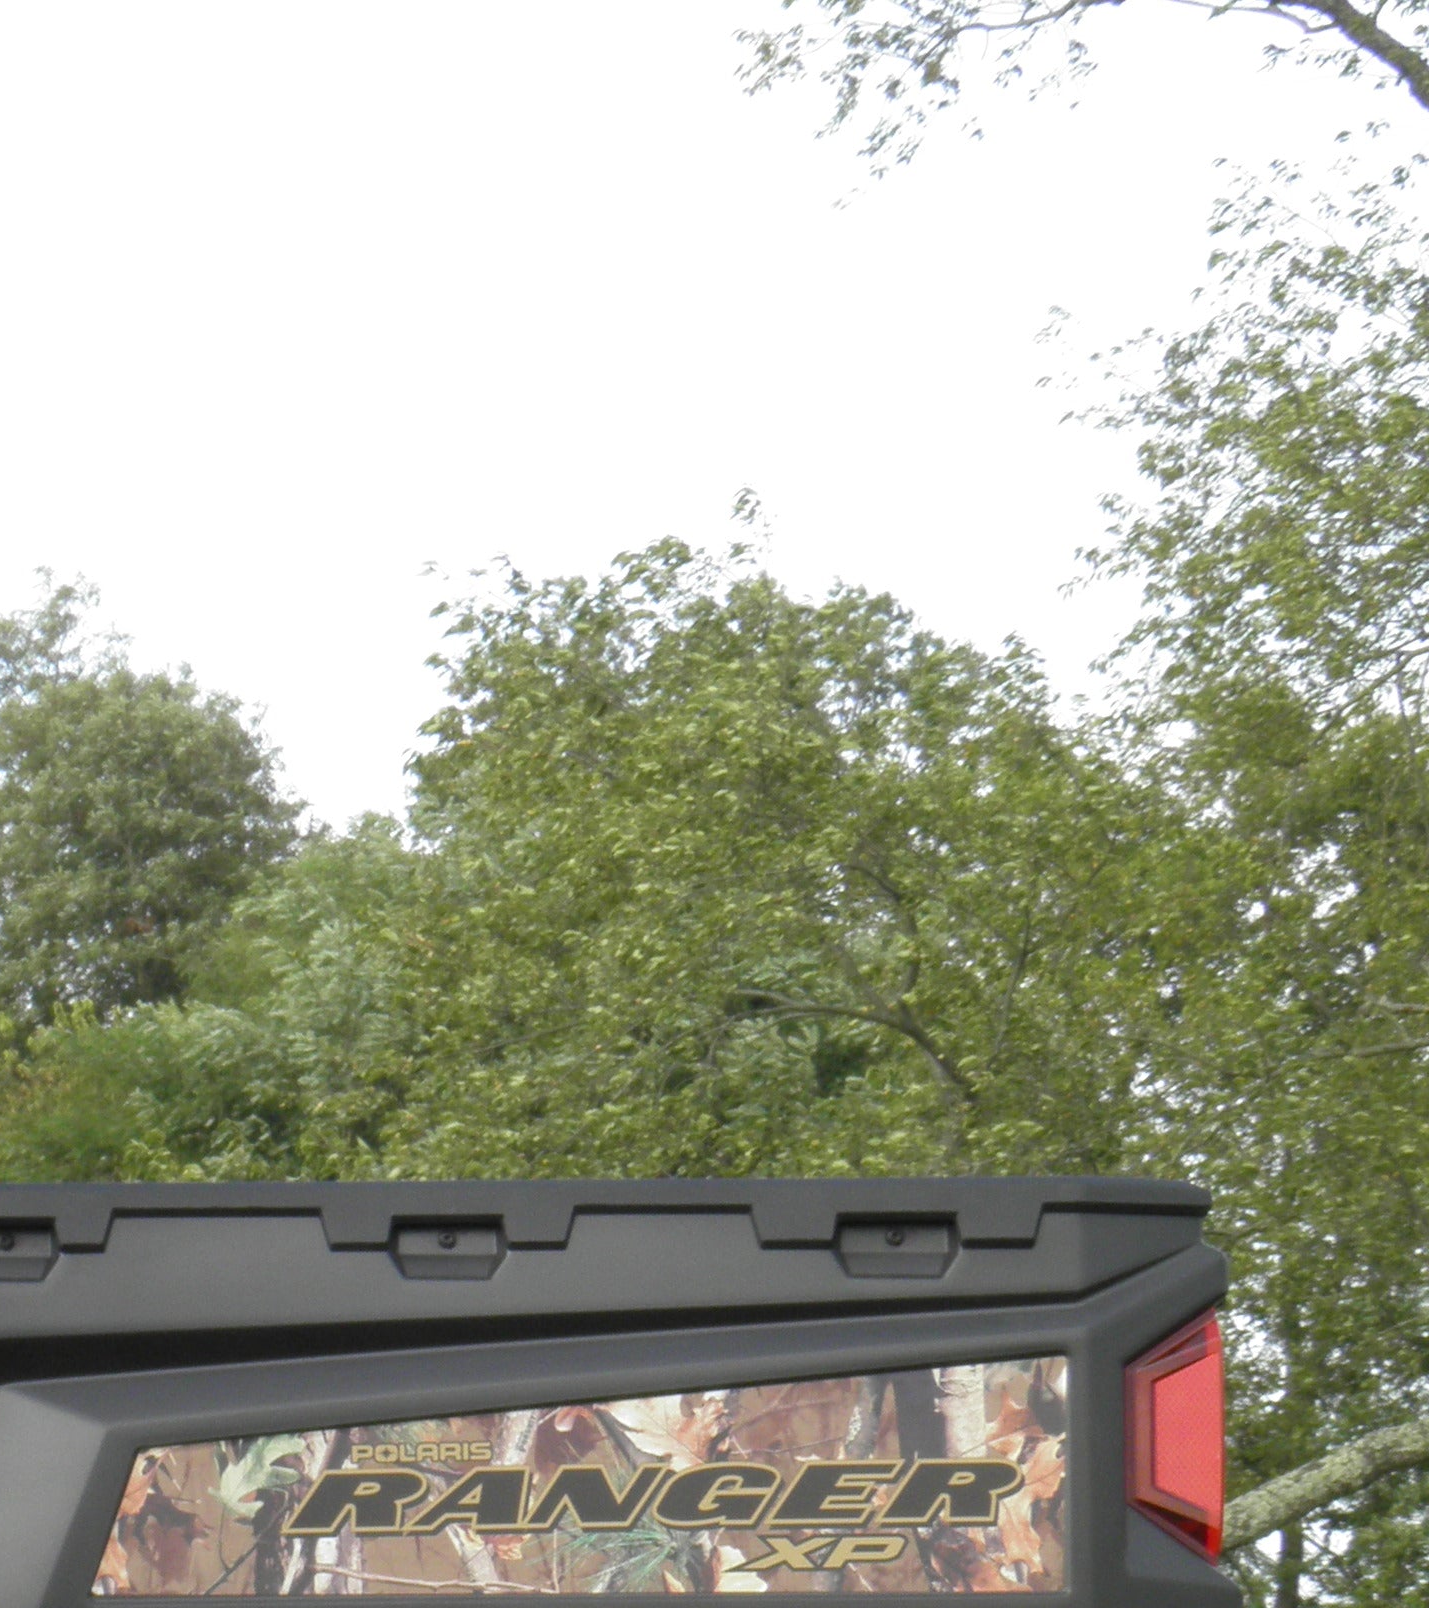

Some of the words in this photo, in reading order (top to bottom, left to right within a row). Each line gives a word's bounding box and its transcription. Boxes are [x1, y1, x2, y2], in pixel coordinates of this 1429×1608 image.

[350, 1440, 492, 1464] POLARIS
[281, 1458, 1024, 1536] RANGER
[723, 1534, 908, 1571] XP
